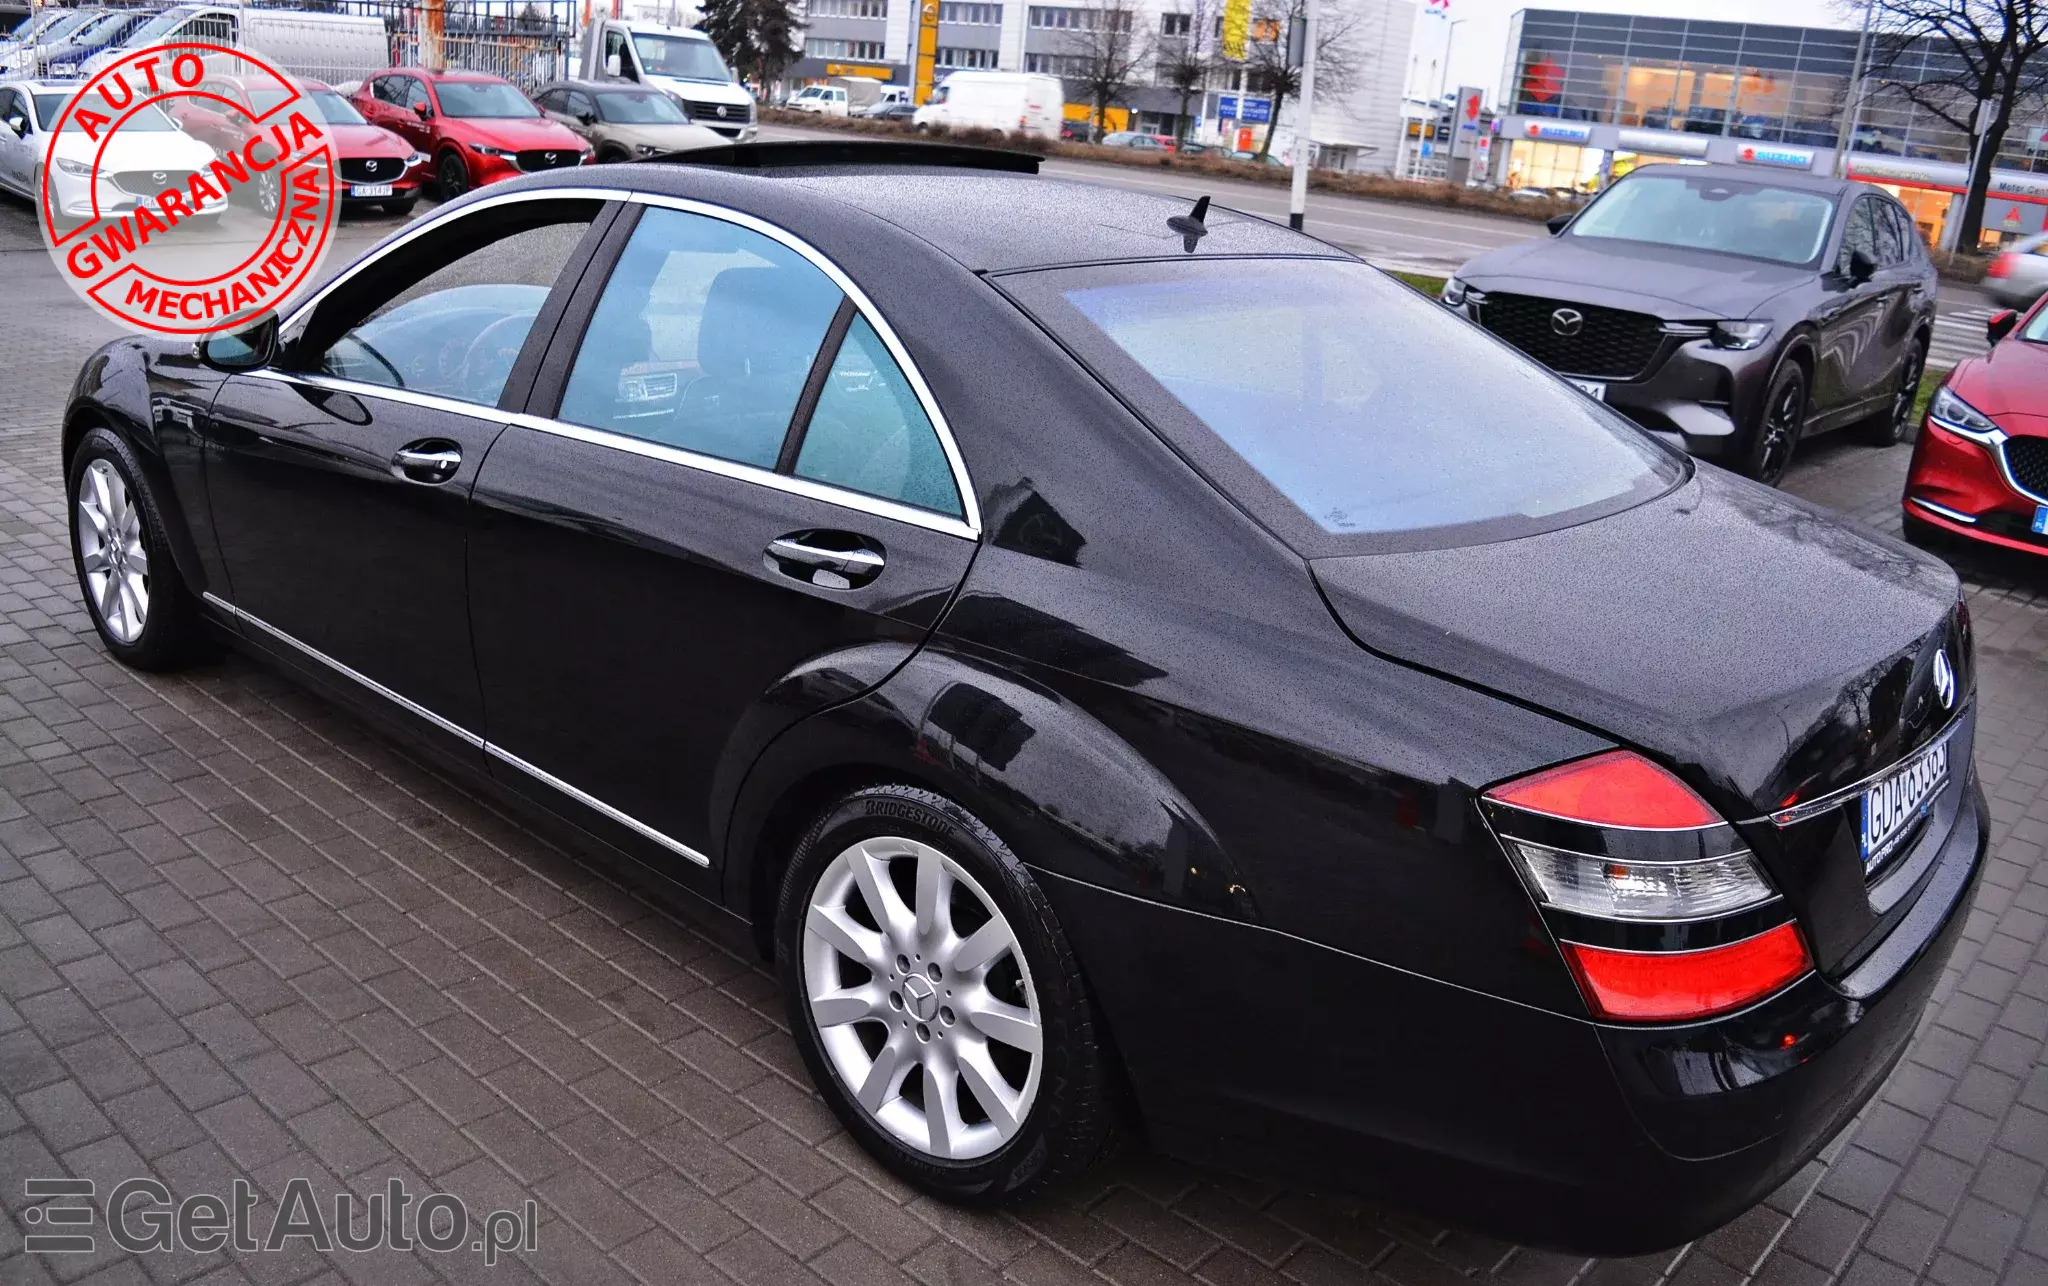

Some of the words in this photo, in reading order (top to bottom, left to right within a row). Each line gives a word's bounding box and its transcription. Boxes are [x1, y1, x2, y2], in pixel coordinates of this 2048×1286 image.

[1755, 151, 1808, 165] SUZUKI
[1999, 182, 2024, 193] Motor
[864, 799, 958, 837] BRIDGESTONE
